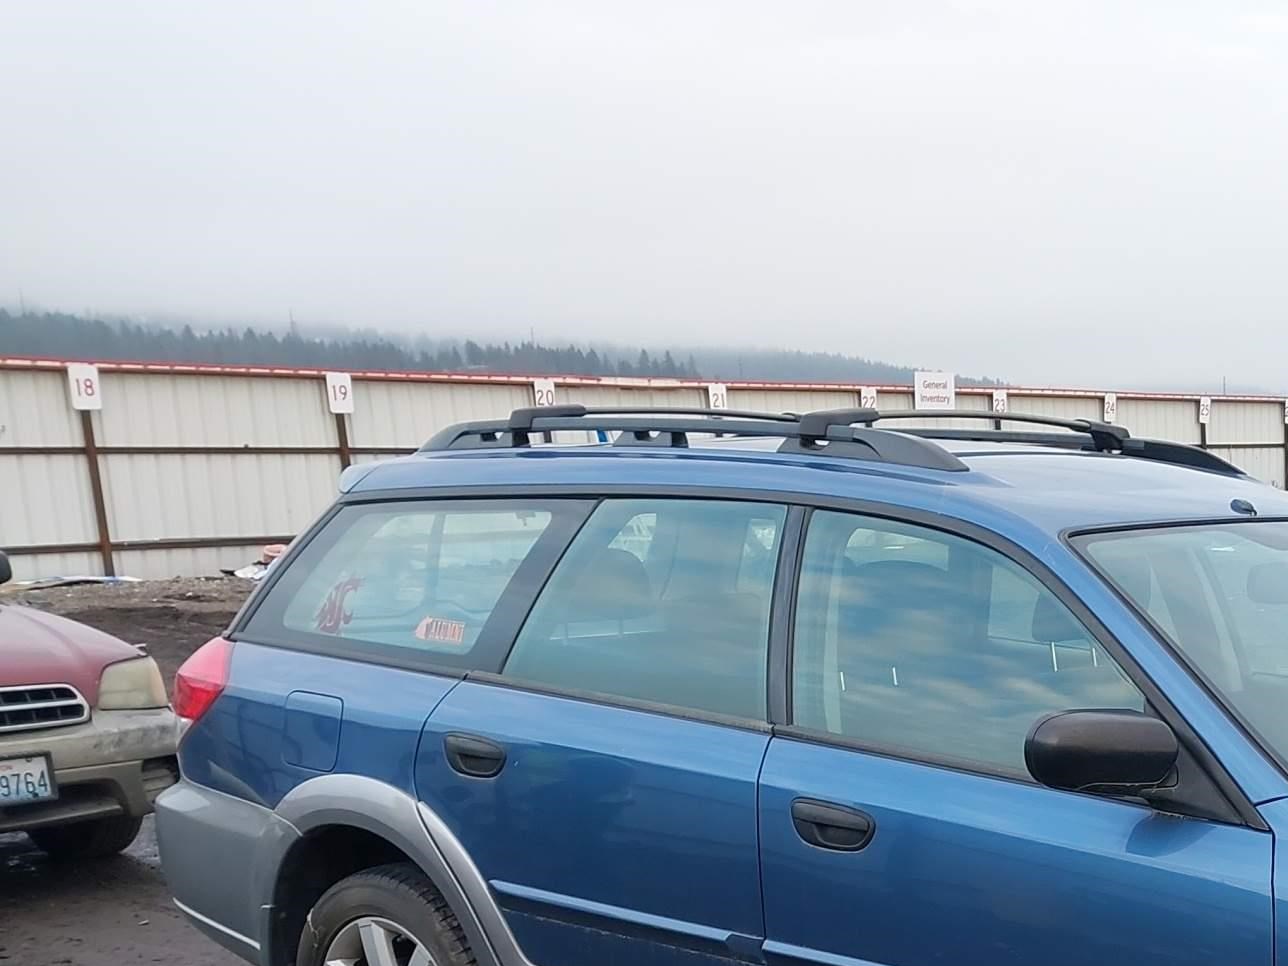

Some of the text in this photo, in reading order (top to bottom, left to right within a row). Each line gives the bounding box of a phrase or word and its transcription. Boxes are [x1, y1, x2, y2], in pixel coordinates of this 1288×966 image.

[75, 378, 95, 397] 18
[922, 380, 948, 389] General
[332, 384, 348, 402] 19
[536, 389, 554, 406] 20
[712, 392, 726, 408] 21
[920, 394, 950, 405] Inventory
[862, 395, 876, 408] 22
[994, 398, 1006, 412] 23
[1105, 401, 1115, 415] 24
[1200, 403, 1209, 416] 25
[0, 770, 48, 797] 9764
